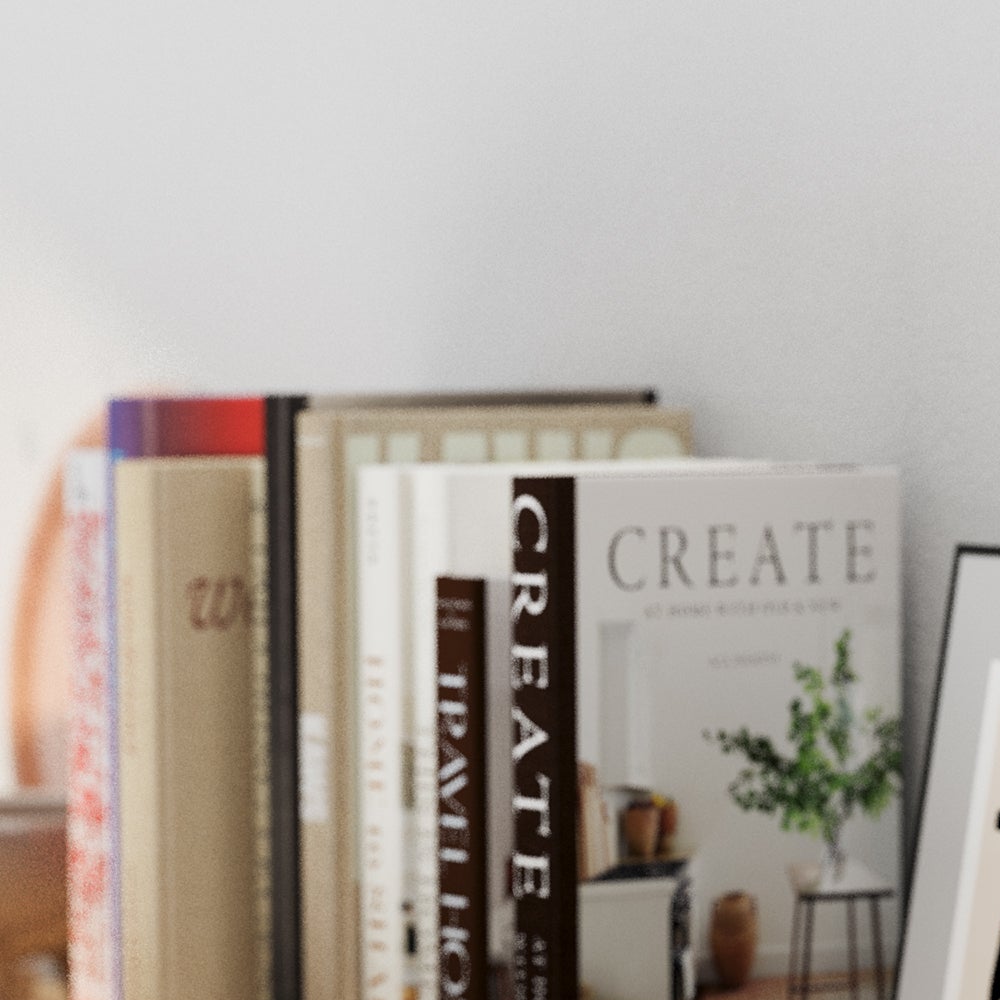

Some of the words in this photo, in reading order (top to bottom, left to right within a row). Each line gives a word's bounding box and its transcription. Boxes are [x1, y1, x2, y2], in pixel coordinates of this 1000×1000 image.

[607, 518, 878, 592] CREATE
[437, 660, 471, 874] TRAVEL
[511, 493, 550, 899] CREATE
